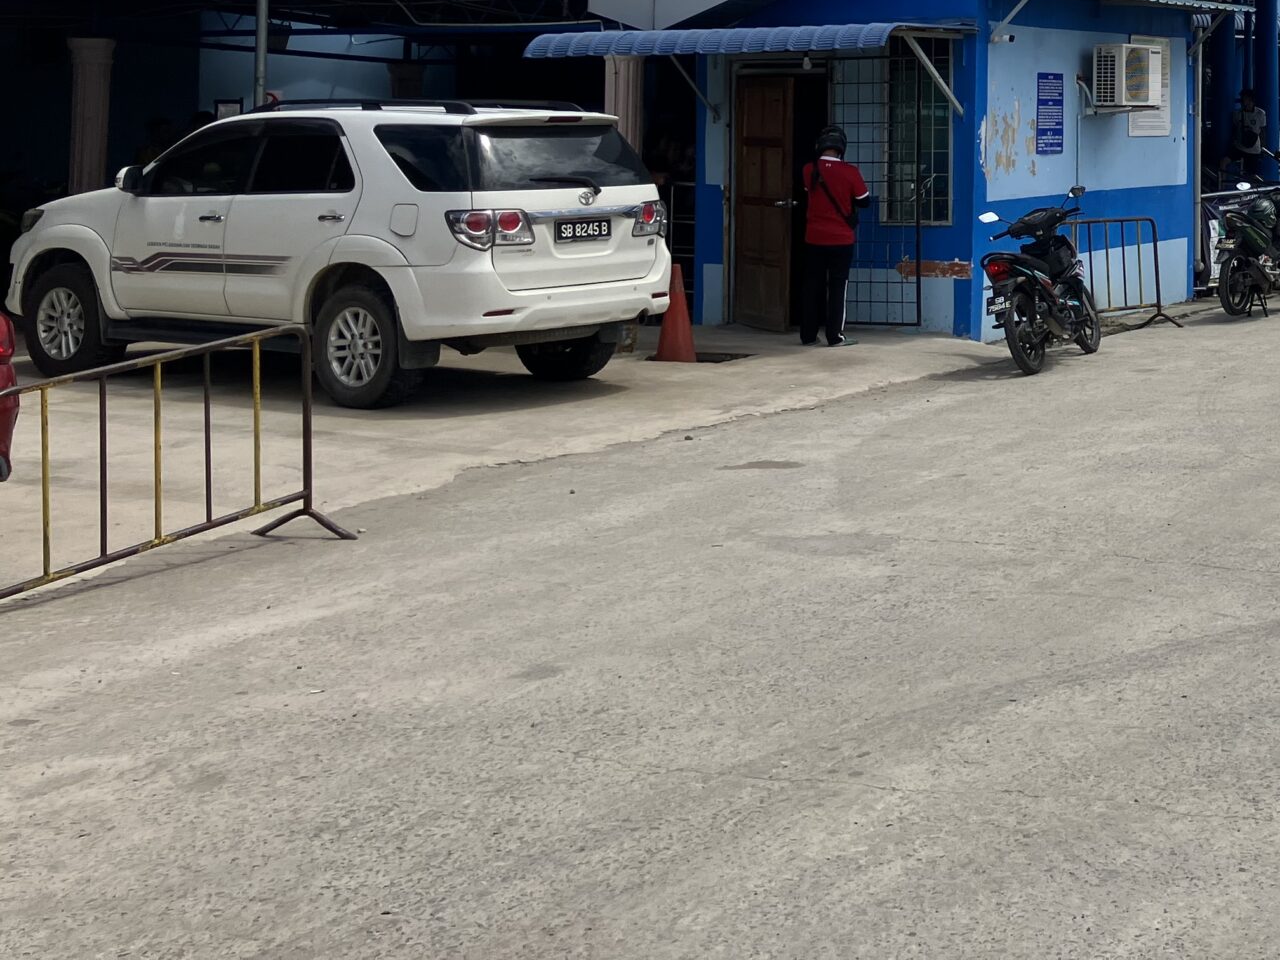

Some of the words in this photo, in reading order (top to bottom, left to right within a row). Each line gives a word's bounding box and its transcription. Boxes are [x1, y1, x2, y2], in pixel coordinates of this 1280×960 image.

[561, 224, 573, 238] SB
[575, 222, 600, 237] 8245
[601, 222, 608, 235] B
